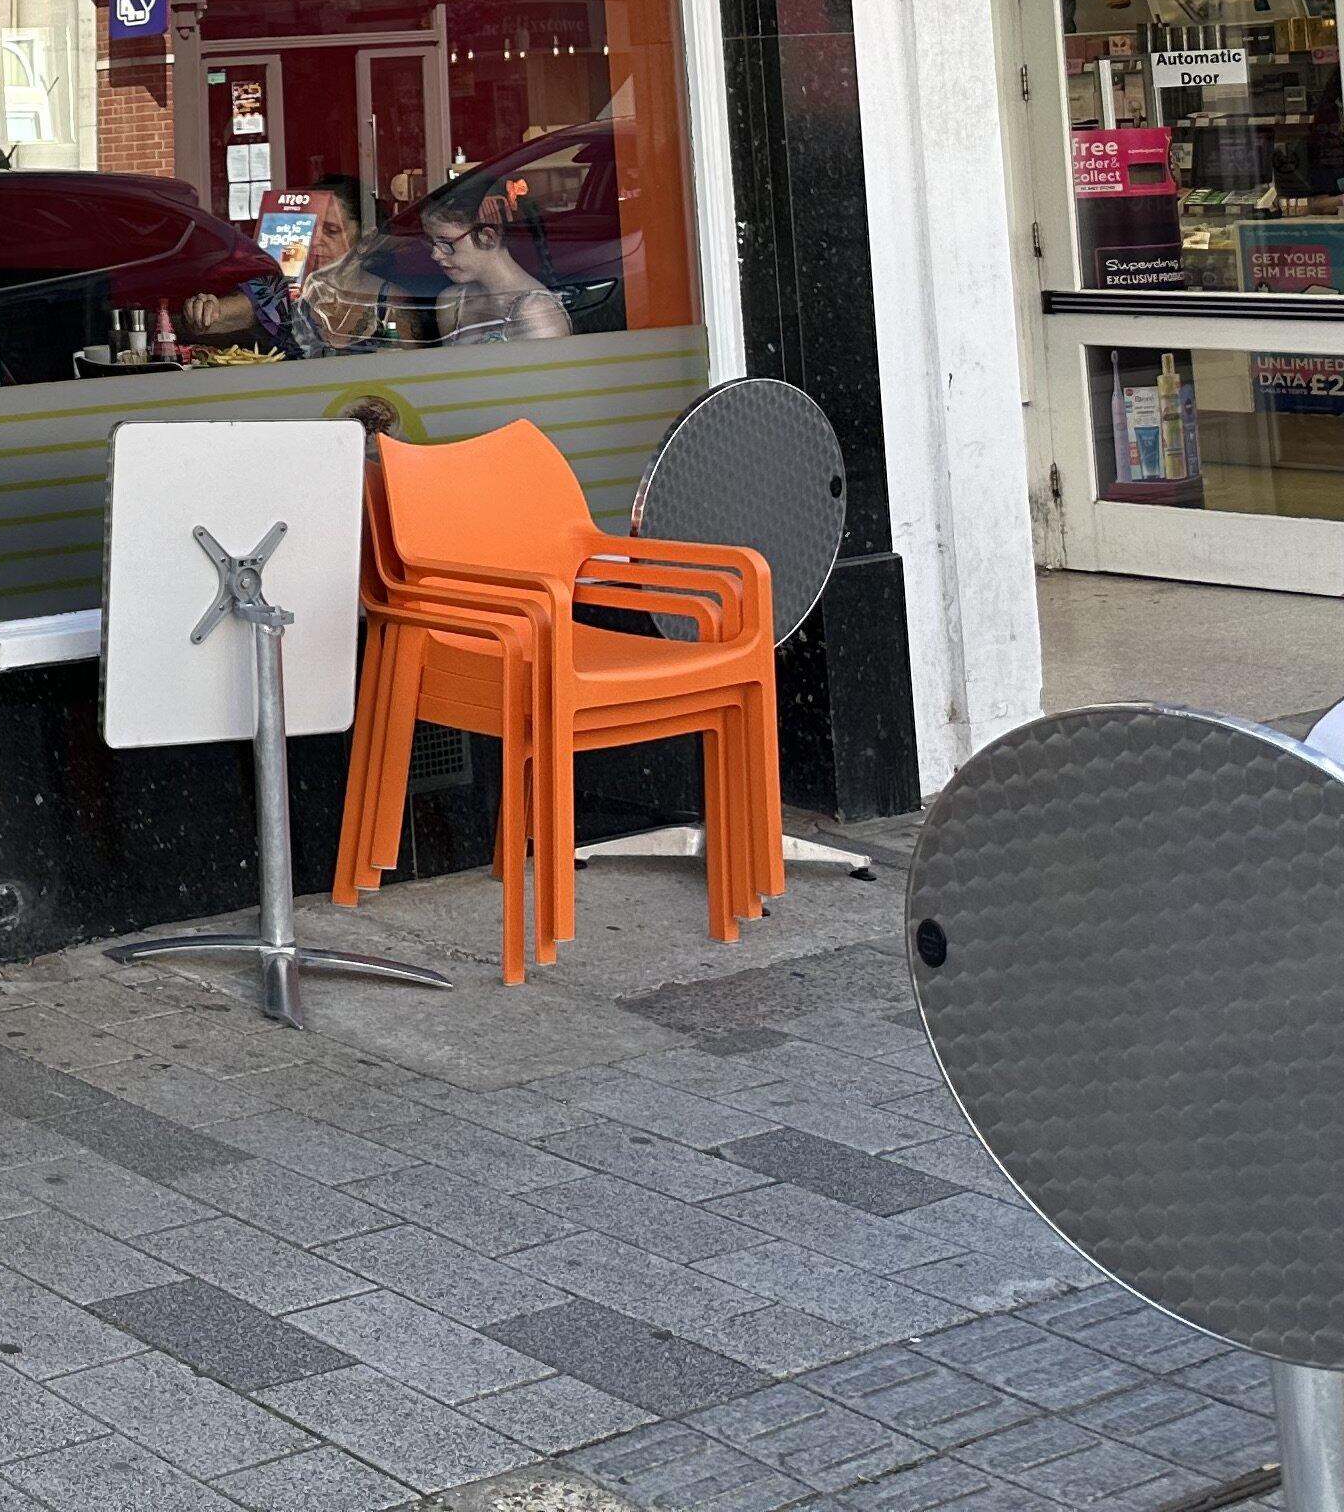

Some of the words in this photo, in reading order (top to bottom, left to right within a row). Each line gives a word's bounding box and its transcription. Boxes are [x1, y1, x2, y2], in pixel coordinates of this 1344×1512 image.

[1156, 50, 1242, 66] Automatic
[1180, 72, 1220, 85] Door
[1072, 138, 1119, 156] free
[1252, 253, 1281, 264] GET
[1284, 252, 1326, 264] YOUR
[1106, 273, 1158, 285] EXCLUSIVE
[1253, 266, 1281, 278] SIM
[1284, 266, 1327, 279] HERE
[1257, 356, 1344, 371] UNLIMITED
[1259, 372, 1307, 387] DATA
